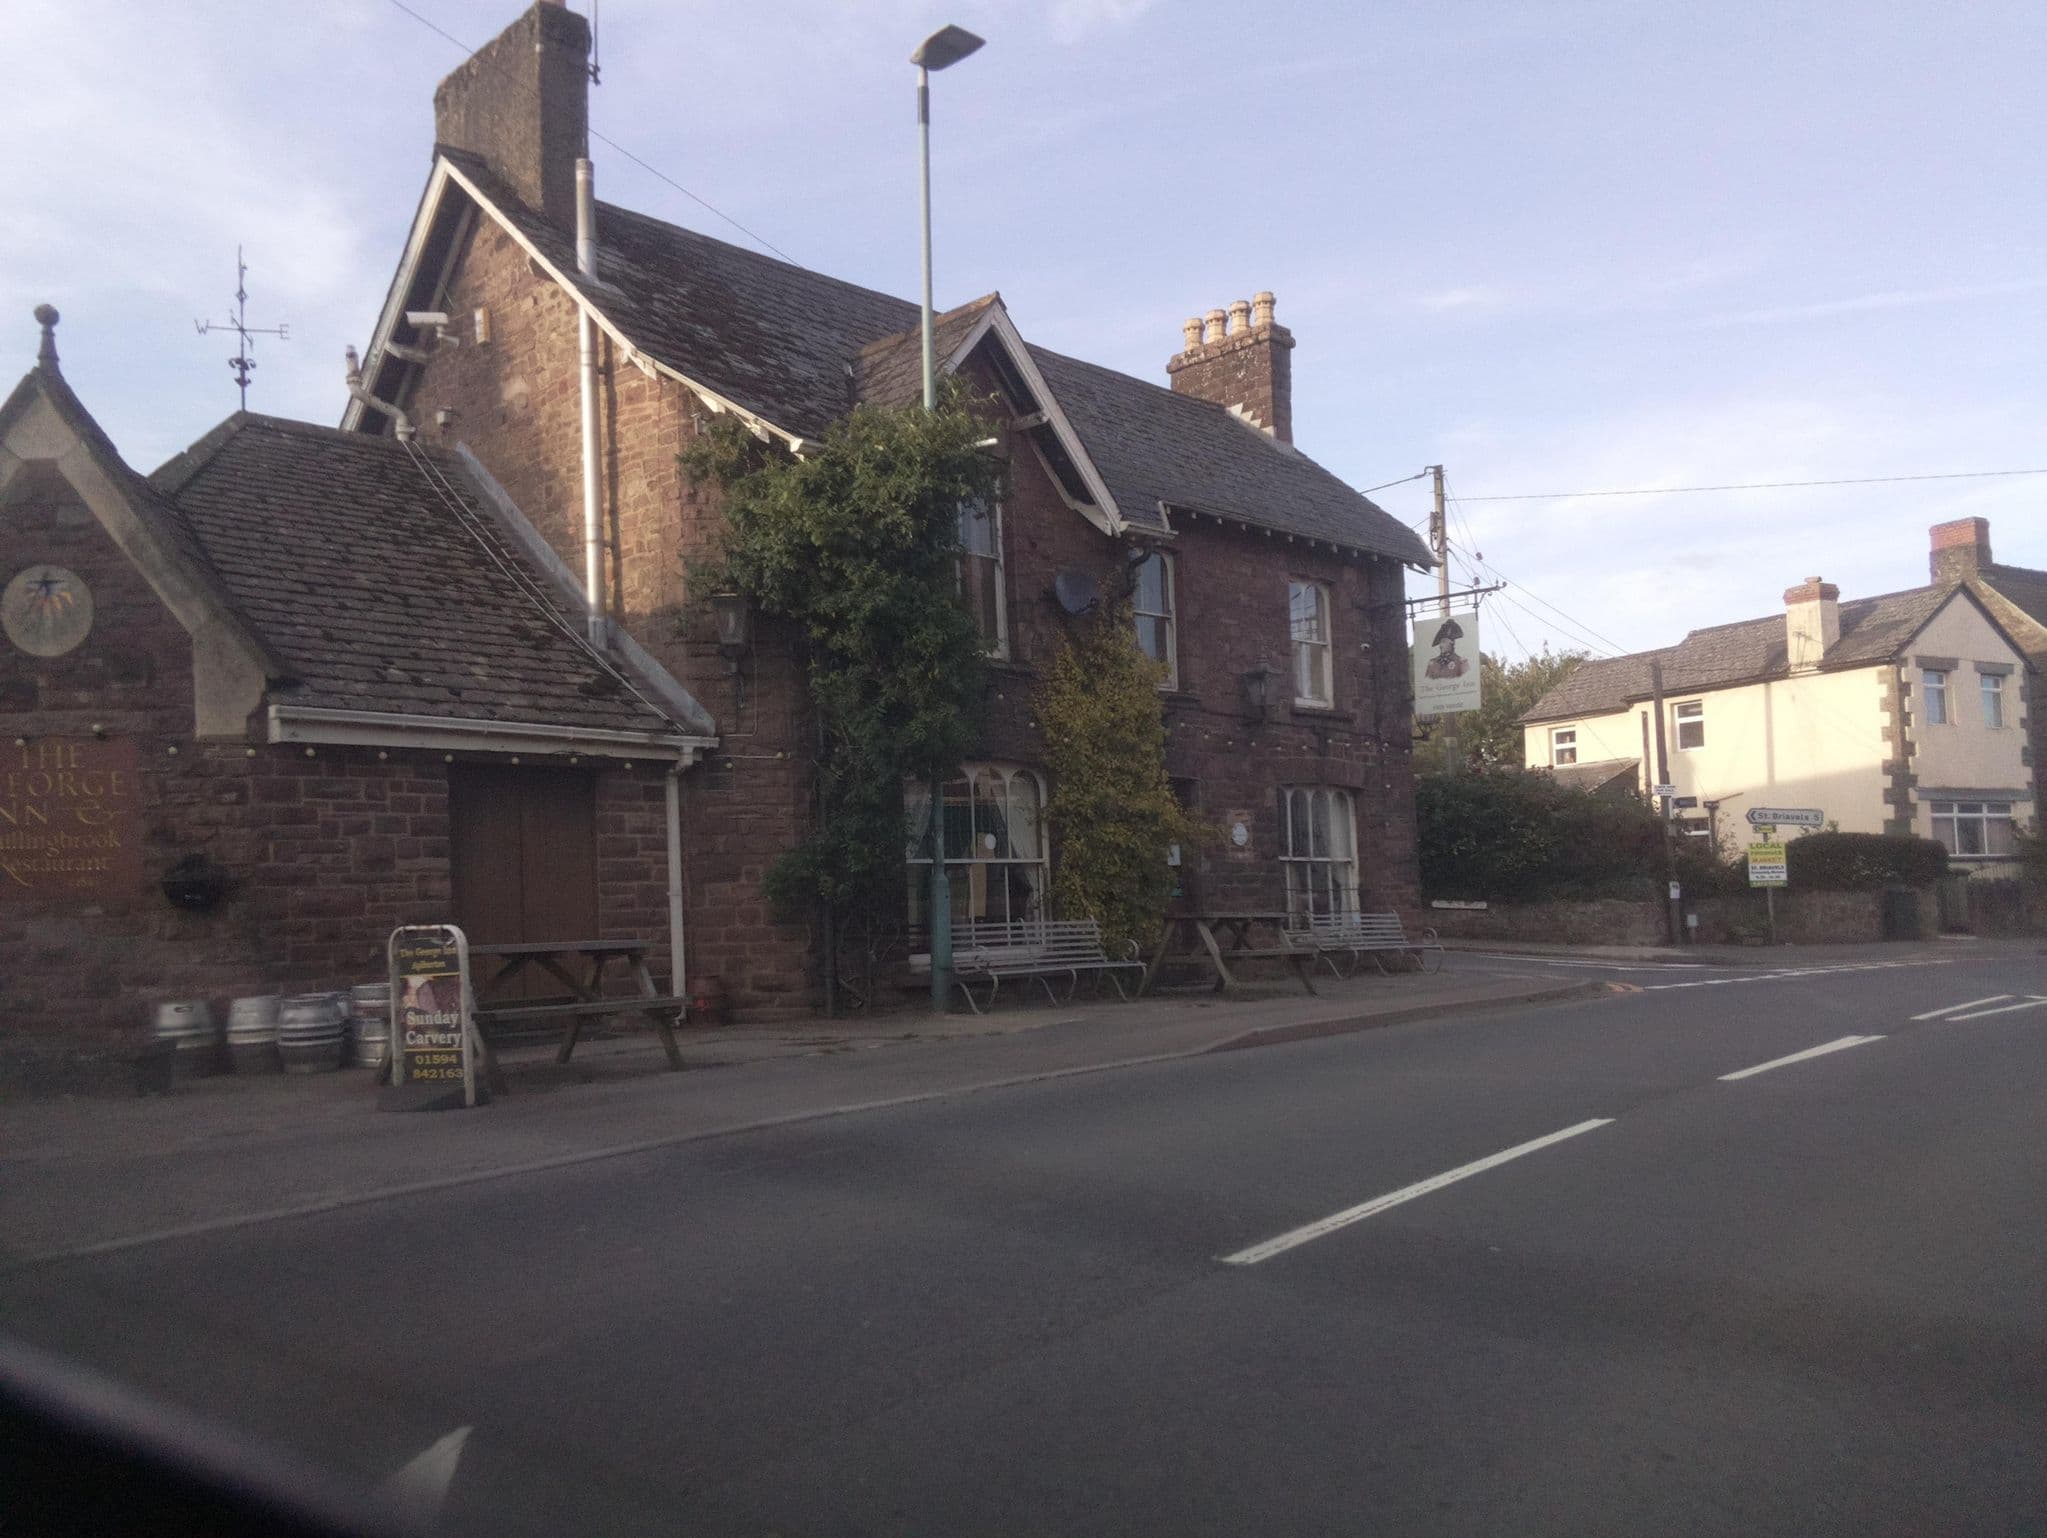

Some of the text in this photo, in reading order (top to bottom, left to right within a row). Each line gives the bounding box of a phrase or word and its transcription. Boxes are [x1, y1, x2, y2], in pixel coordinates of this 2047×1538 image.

[406, 1010, 459, 1028] Sunday
[406, 1030, 462, 1048] Carvery
[416, 1054, 457, 1065] 01594
